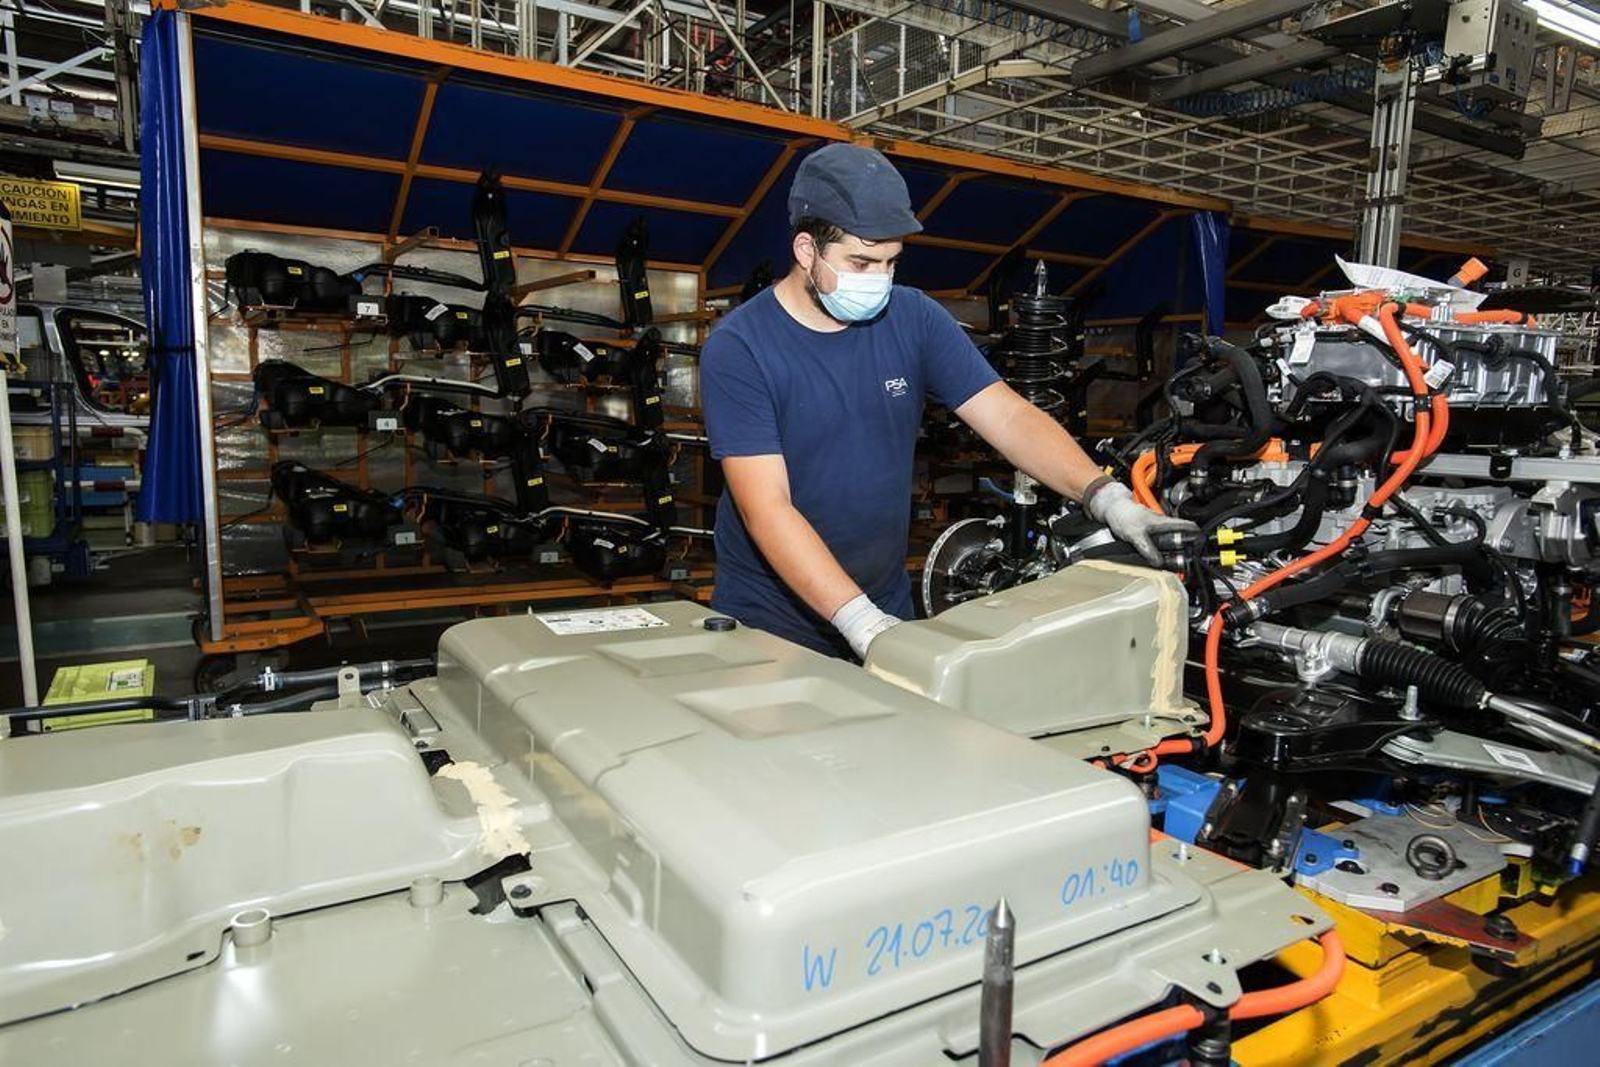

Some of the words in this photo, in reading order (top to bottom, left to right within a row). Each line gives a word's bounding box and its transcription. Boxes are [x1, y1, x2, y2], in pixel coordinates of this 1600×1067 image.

[1, 196, 47, 210] INGAS
[51, 201, 69, 212] EN
[11, 210, 70, 225] IMIENTO
[885, 377, 908, 391] PSA
[803, 944, 836, 991] W
[1061, 857, 1138, 905] 01:40
